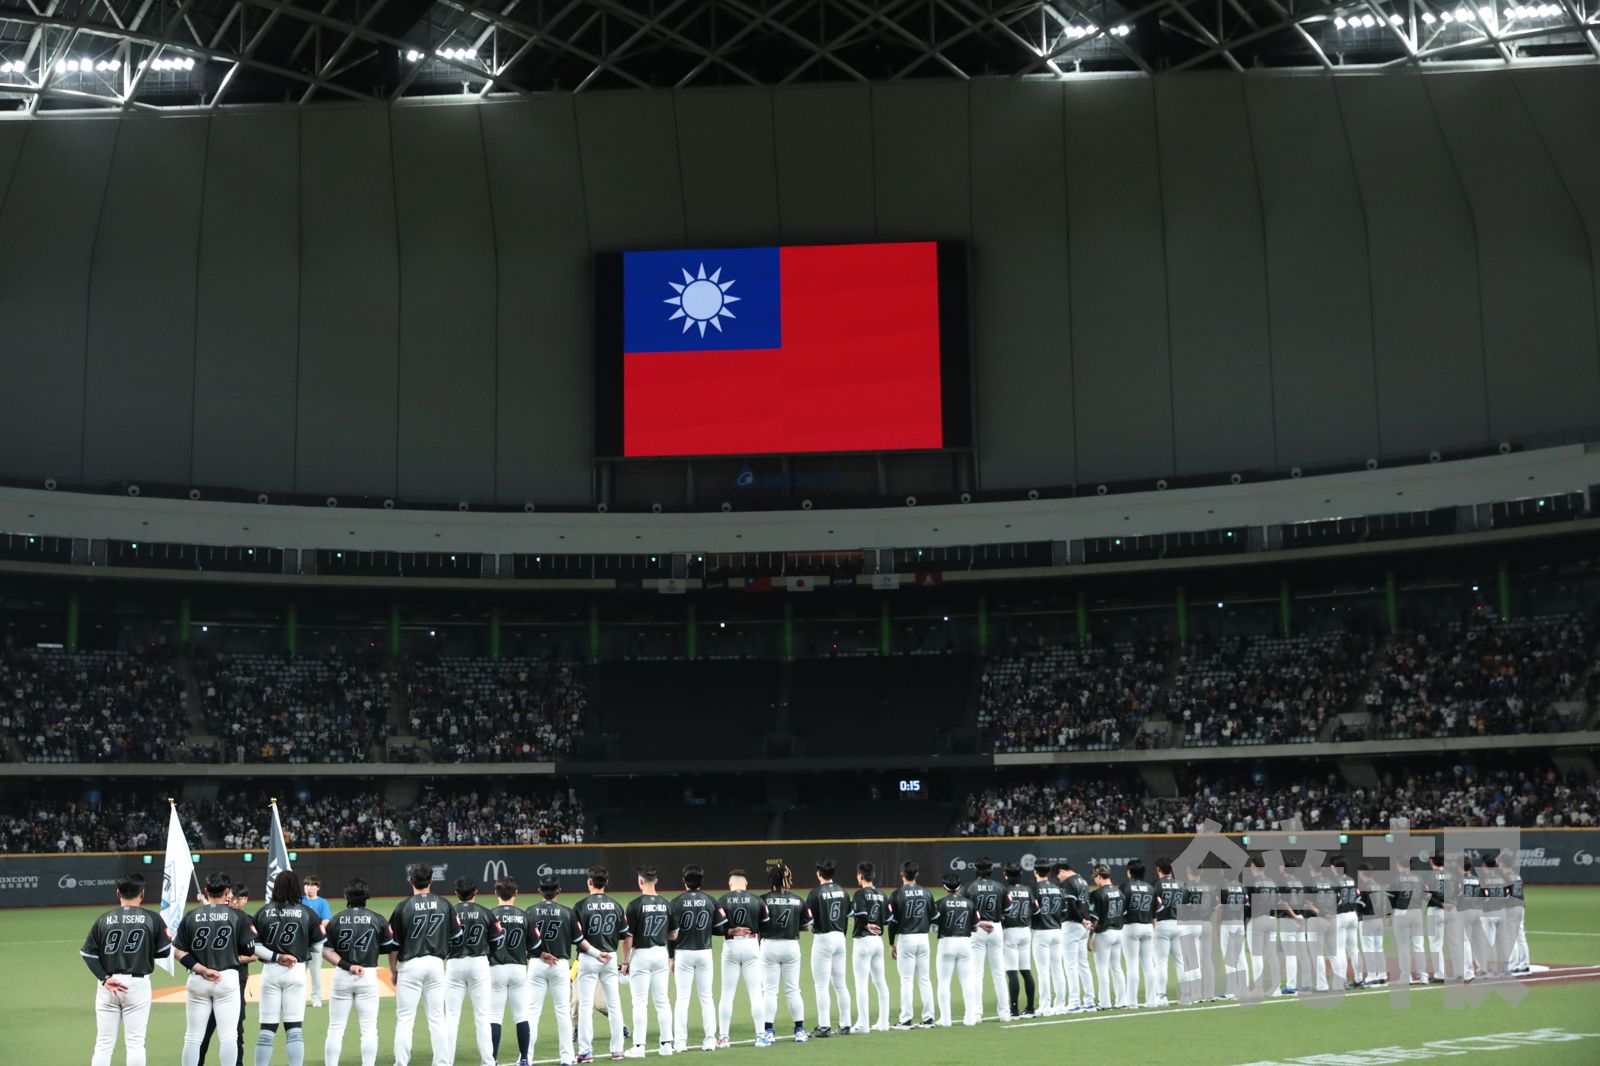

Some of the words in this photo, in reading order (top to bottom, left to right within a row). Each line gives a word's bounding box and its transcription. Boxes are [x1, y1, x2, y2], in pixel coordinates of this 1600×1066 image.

[900, 780, 920, 791] 0:15
[428, 902, 437, 910] LIN
[600, 902, 615, 910] CHEN
[642, 904, 667, 913] FAIRCHILD
[694, 899, 706, 907] HSU
[830, 901, 841, 921] 6
[905, 899, 926, 918] 12
[976, 894, 997, 912] 16
[1008, 900, 1030, 918] 20
[1041, 896, 1062, 915] 37
[1130, 893, 1153, 911] 52
[106, 915, 119, 925] H.J.
[122, 915, 145, 924] TSENG
[195, 913, 208, 923] C.J.
[209, 913, 229, 922] SUNG
[265, 908, 278, 917] Y.C.
[339, 916, 352, 925] C.H.
[353, 916, 371, 924] CHEN
[467, 911, 479, 919] WU
[502, 915, 524, 924] CHIANG
[550, 909, 560, 917] LIN
[680, 911, 709, 931] 00
[733, 907, 747, 925] 0
[775, 908, 791, 928] 4
[945, 910, 969, 929] 14
[266, 922, 298, 945] 18
[411, 914, 445, 939] 77
[535, 920, 561, 941] 15
[588, 914, 616, 936] 98
[644, 915, 667, 937] 17
[104, 929, 145, 955] 99
[191, 926, 232, 951] 88
[336, 929, 374, 952] 24
